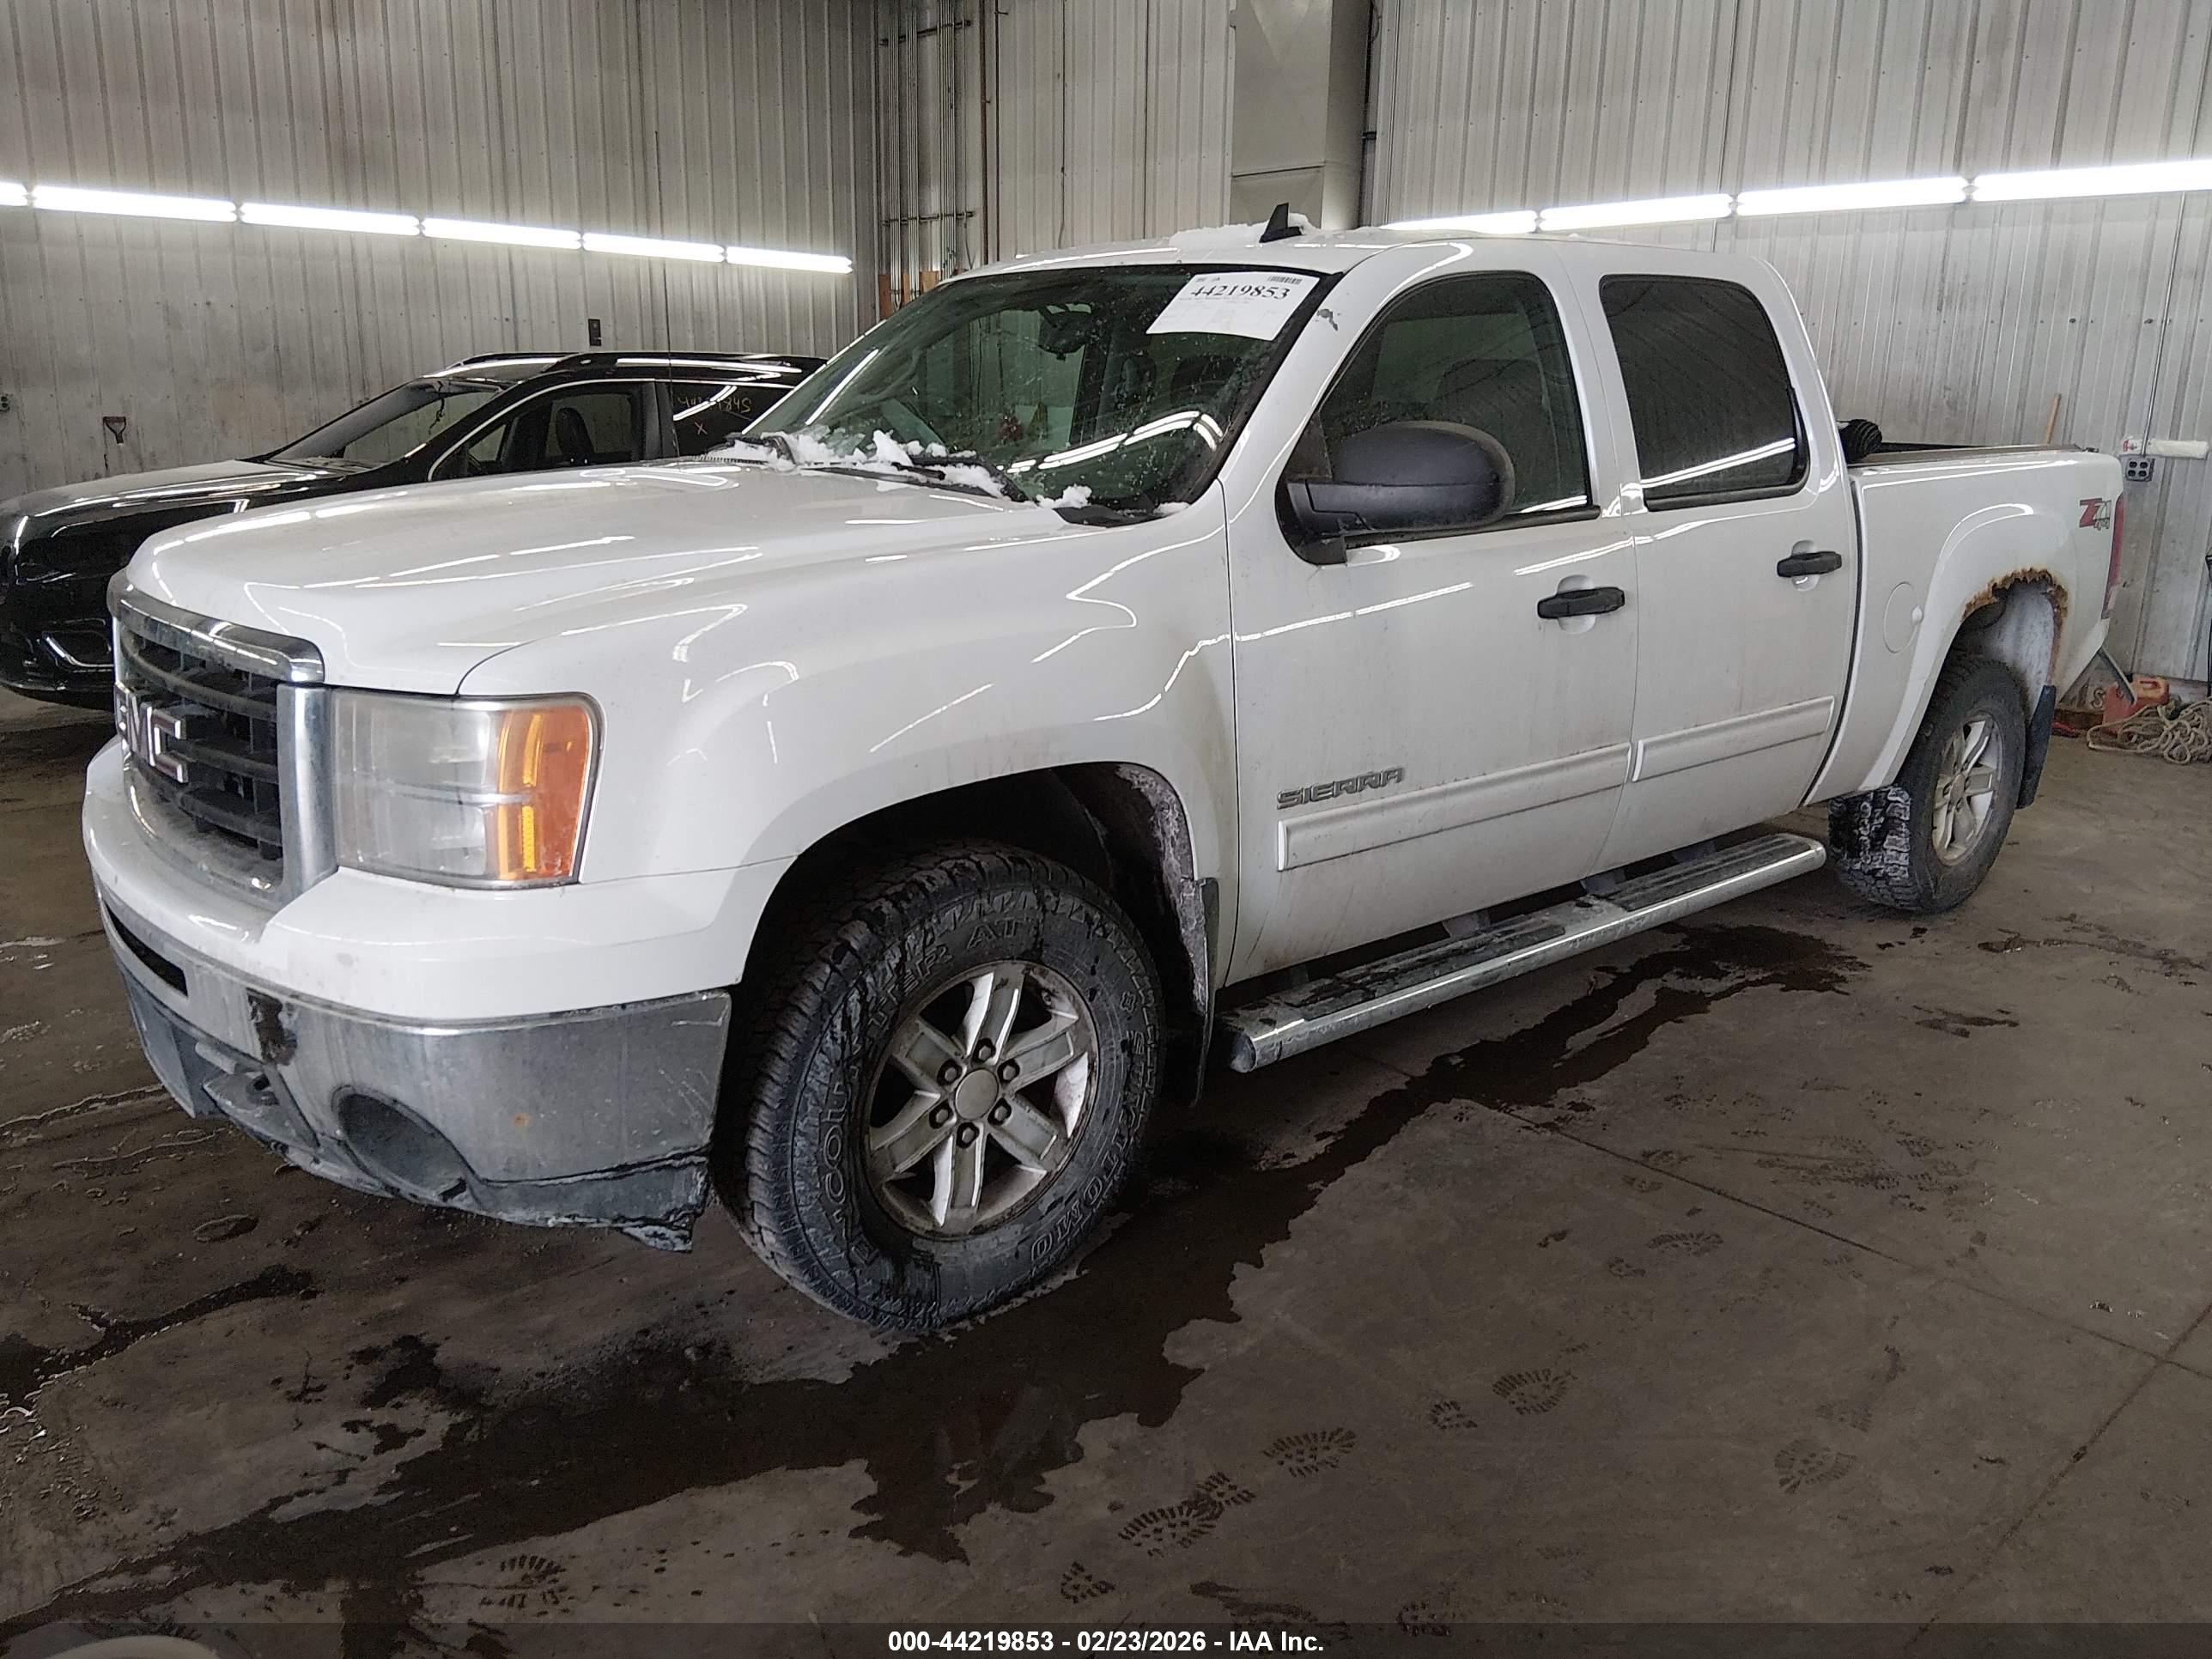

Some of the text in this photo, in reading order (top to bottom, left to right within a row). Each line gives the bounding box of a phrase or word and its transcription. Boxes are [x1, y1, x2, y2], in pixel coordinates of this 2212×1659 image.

[1190, 284, 1291, 300] 44219853
[2079, 497, 2112, 528] Z71
[1276, 767, 1405, 811] SIERRA
[967, 917, 1027, 951] AT
